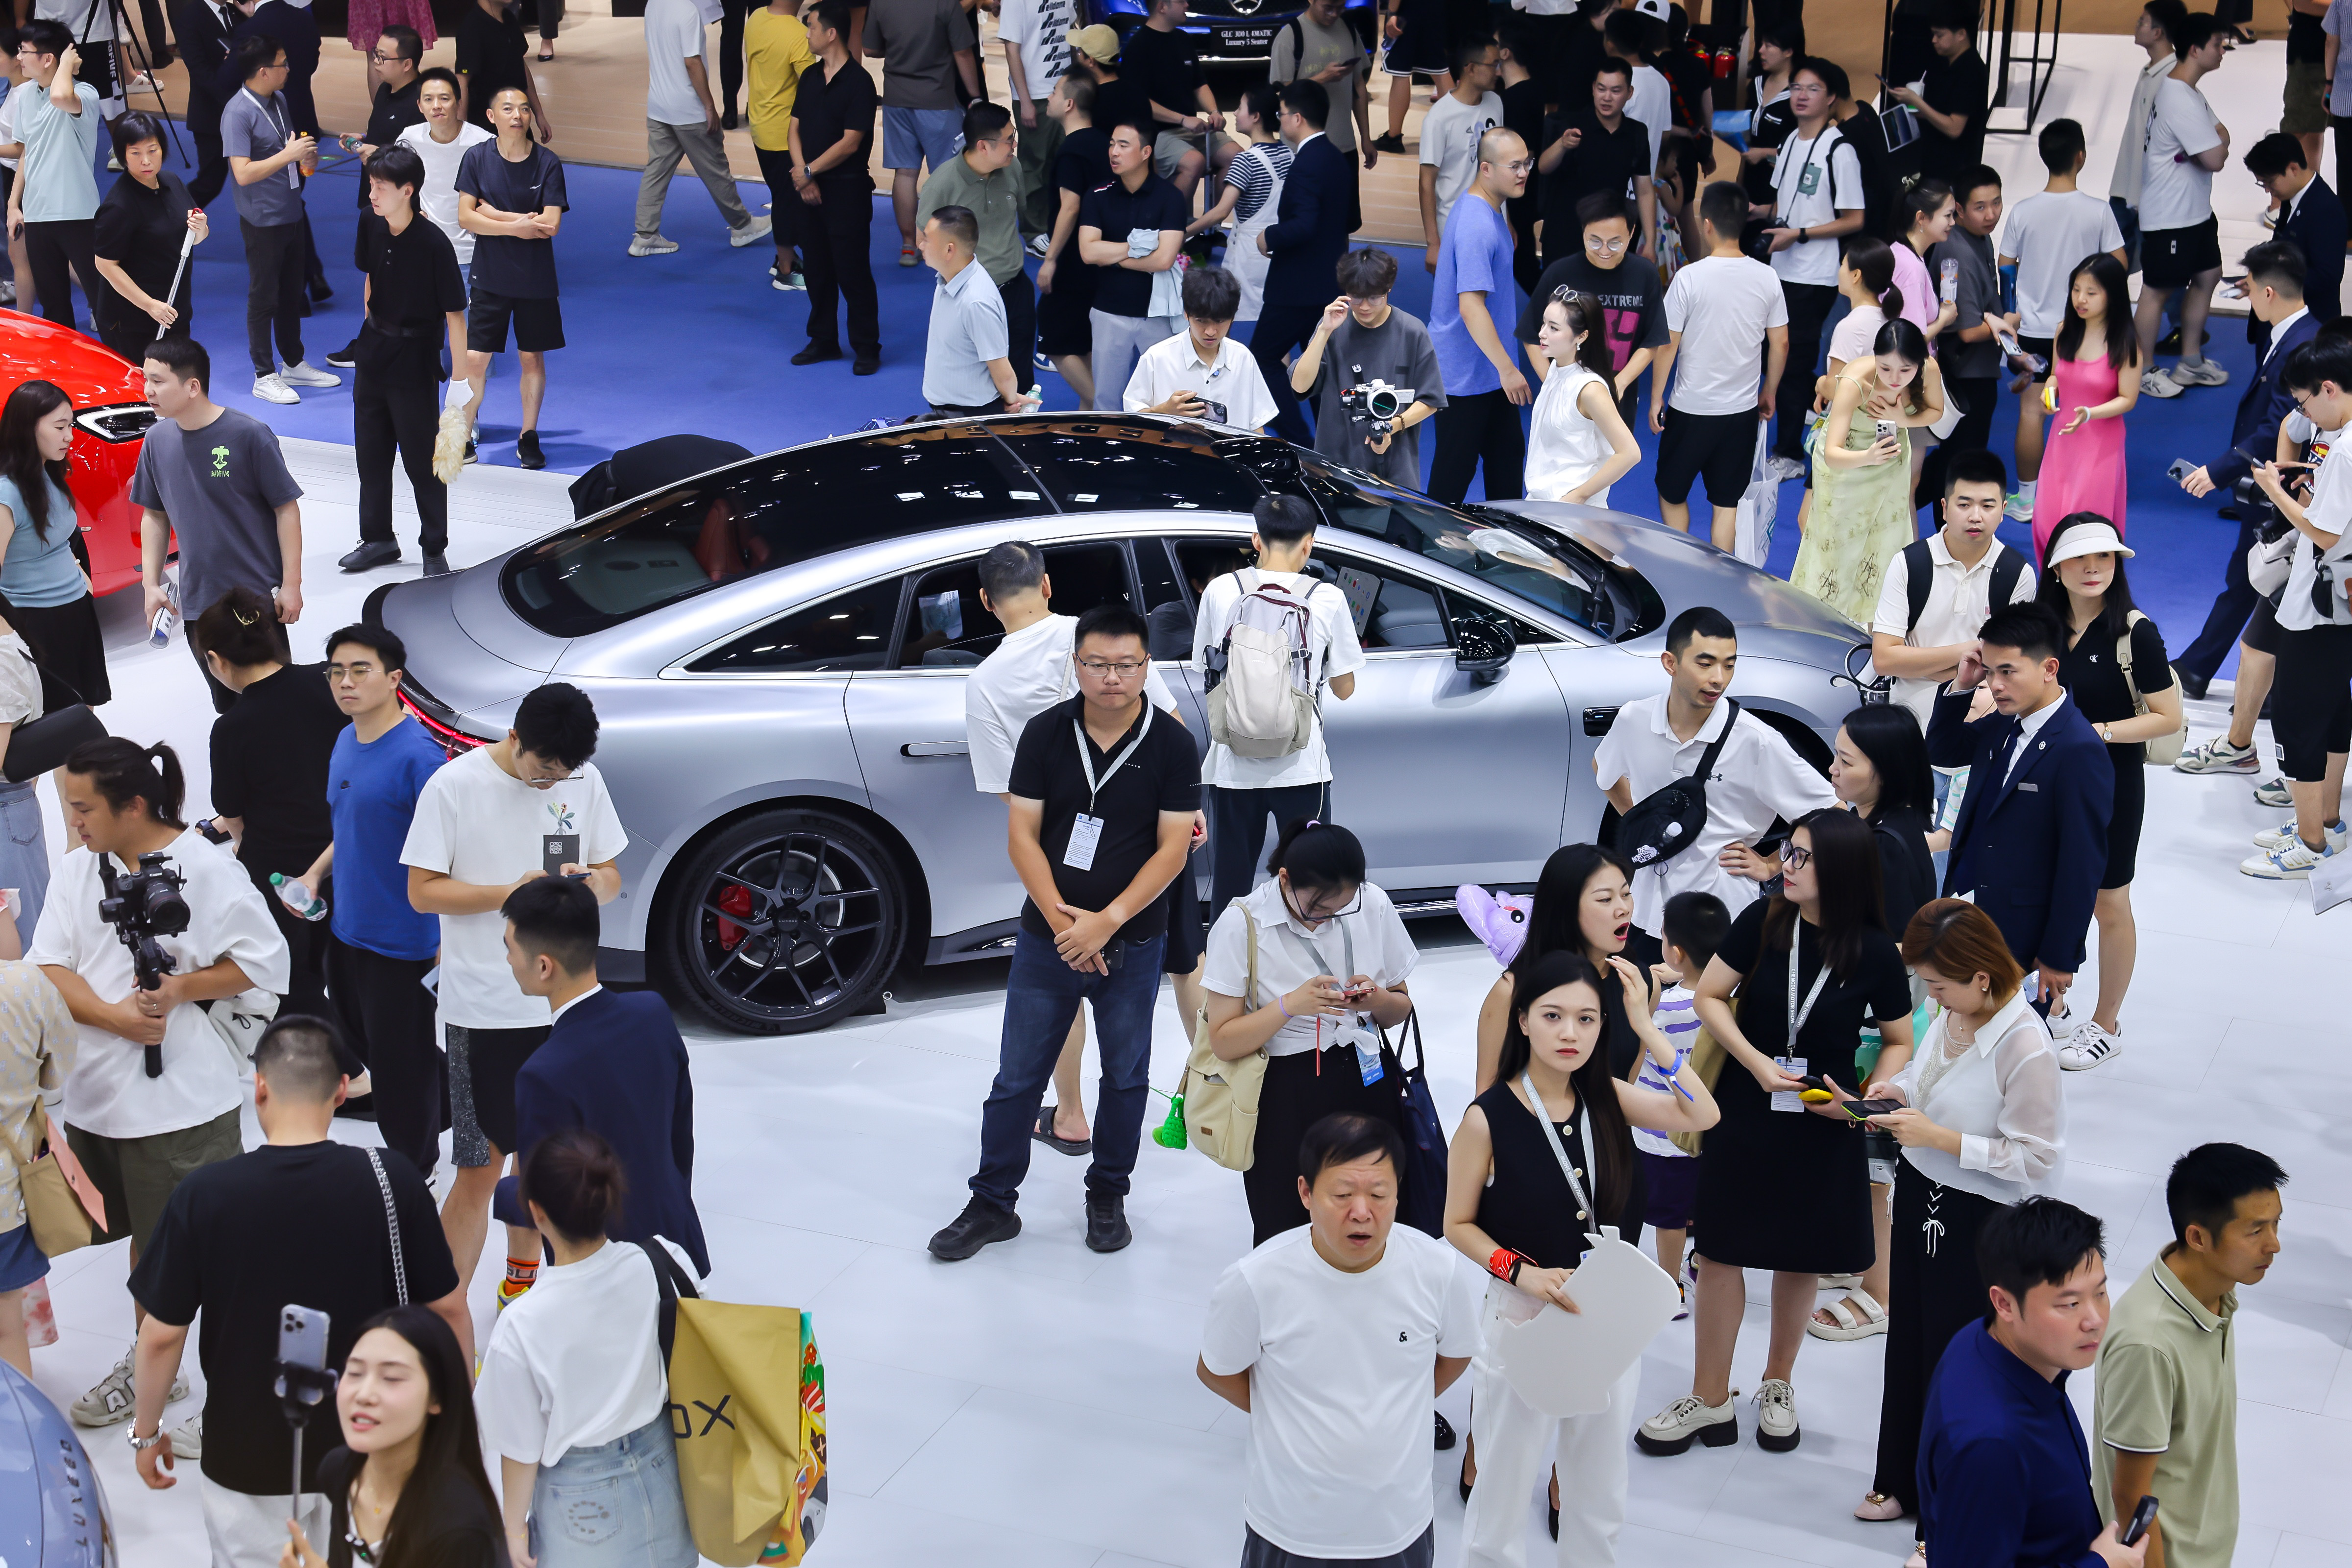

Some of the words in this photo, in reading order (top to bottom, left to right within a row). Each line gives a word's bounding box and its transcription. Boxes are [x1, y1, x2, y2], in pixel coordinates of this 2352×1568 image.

[820, 819, 872, 850] MICHELIN
[1796, 1007, 1809, 1027] CHENGDU
[1805, 990, 1817, 1008] MOTOR
[1813, 978, 1824, 992] SHOW
[1529, 1090, 1543, 1109] MOTOR
[1538, 1109, 1553, 1134] CHENGDU
[1560, 1155, 1570, 1171] SHOW
[1568, 1171, 1579, 1189] MOTOR
[1576, 1189, 1589, 1211] CHENGDU
